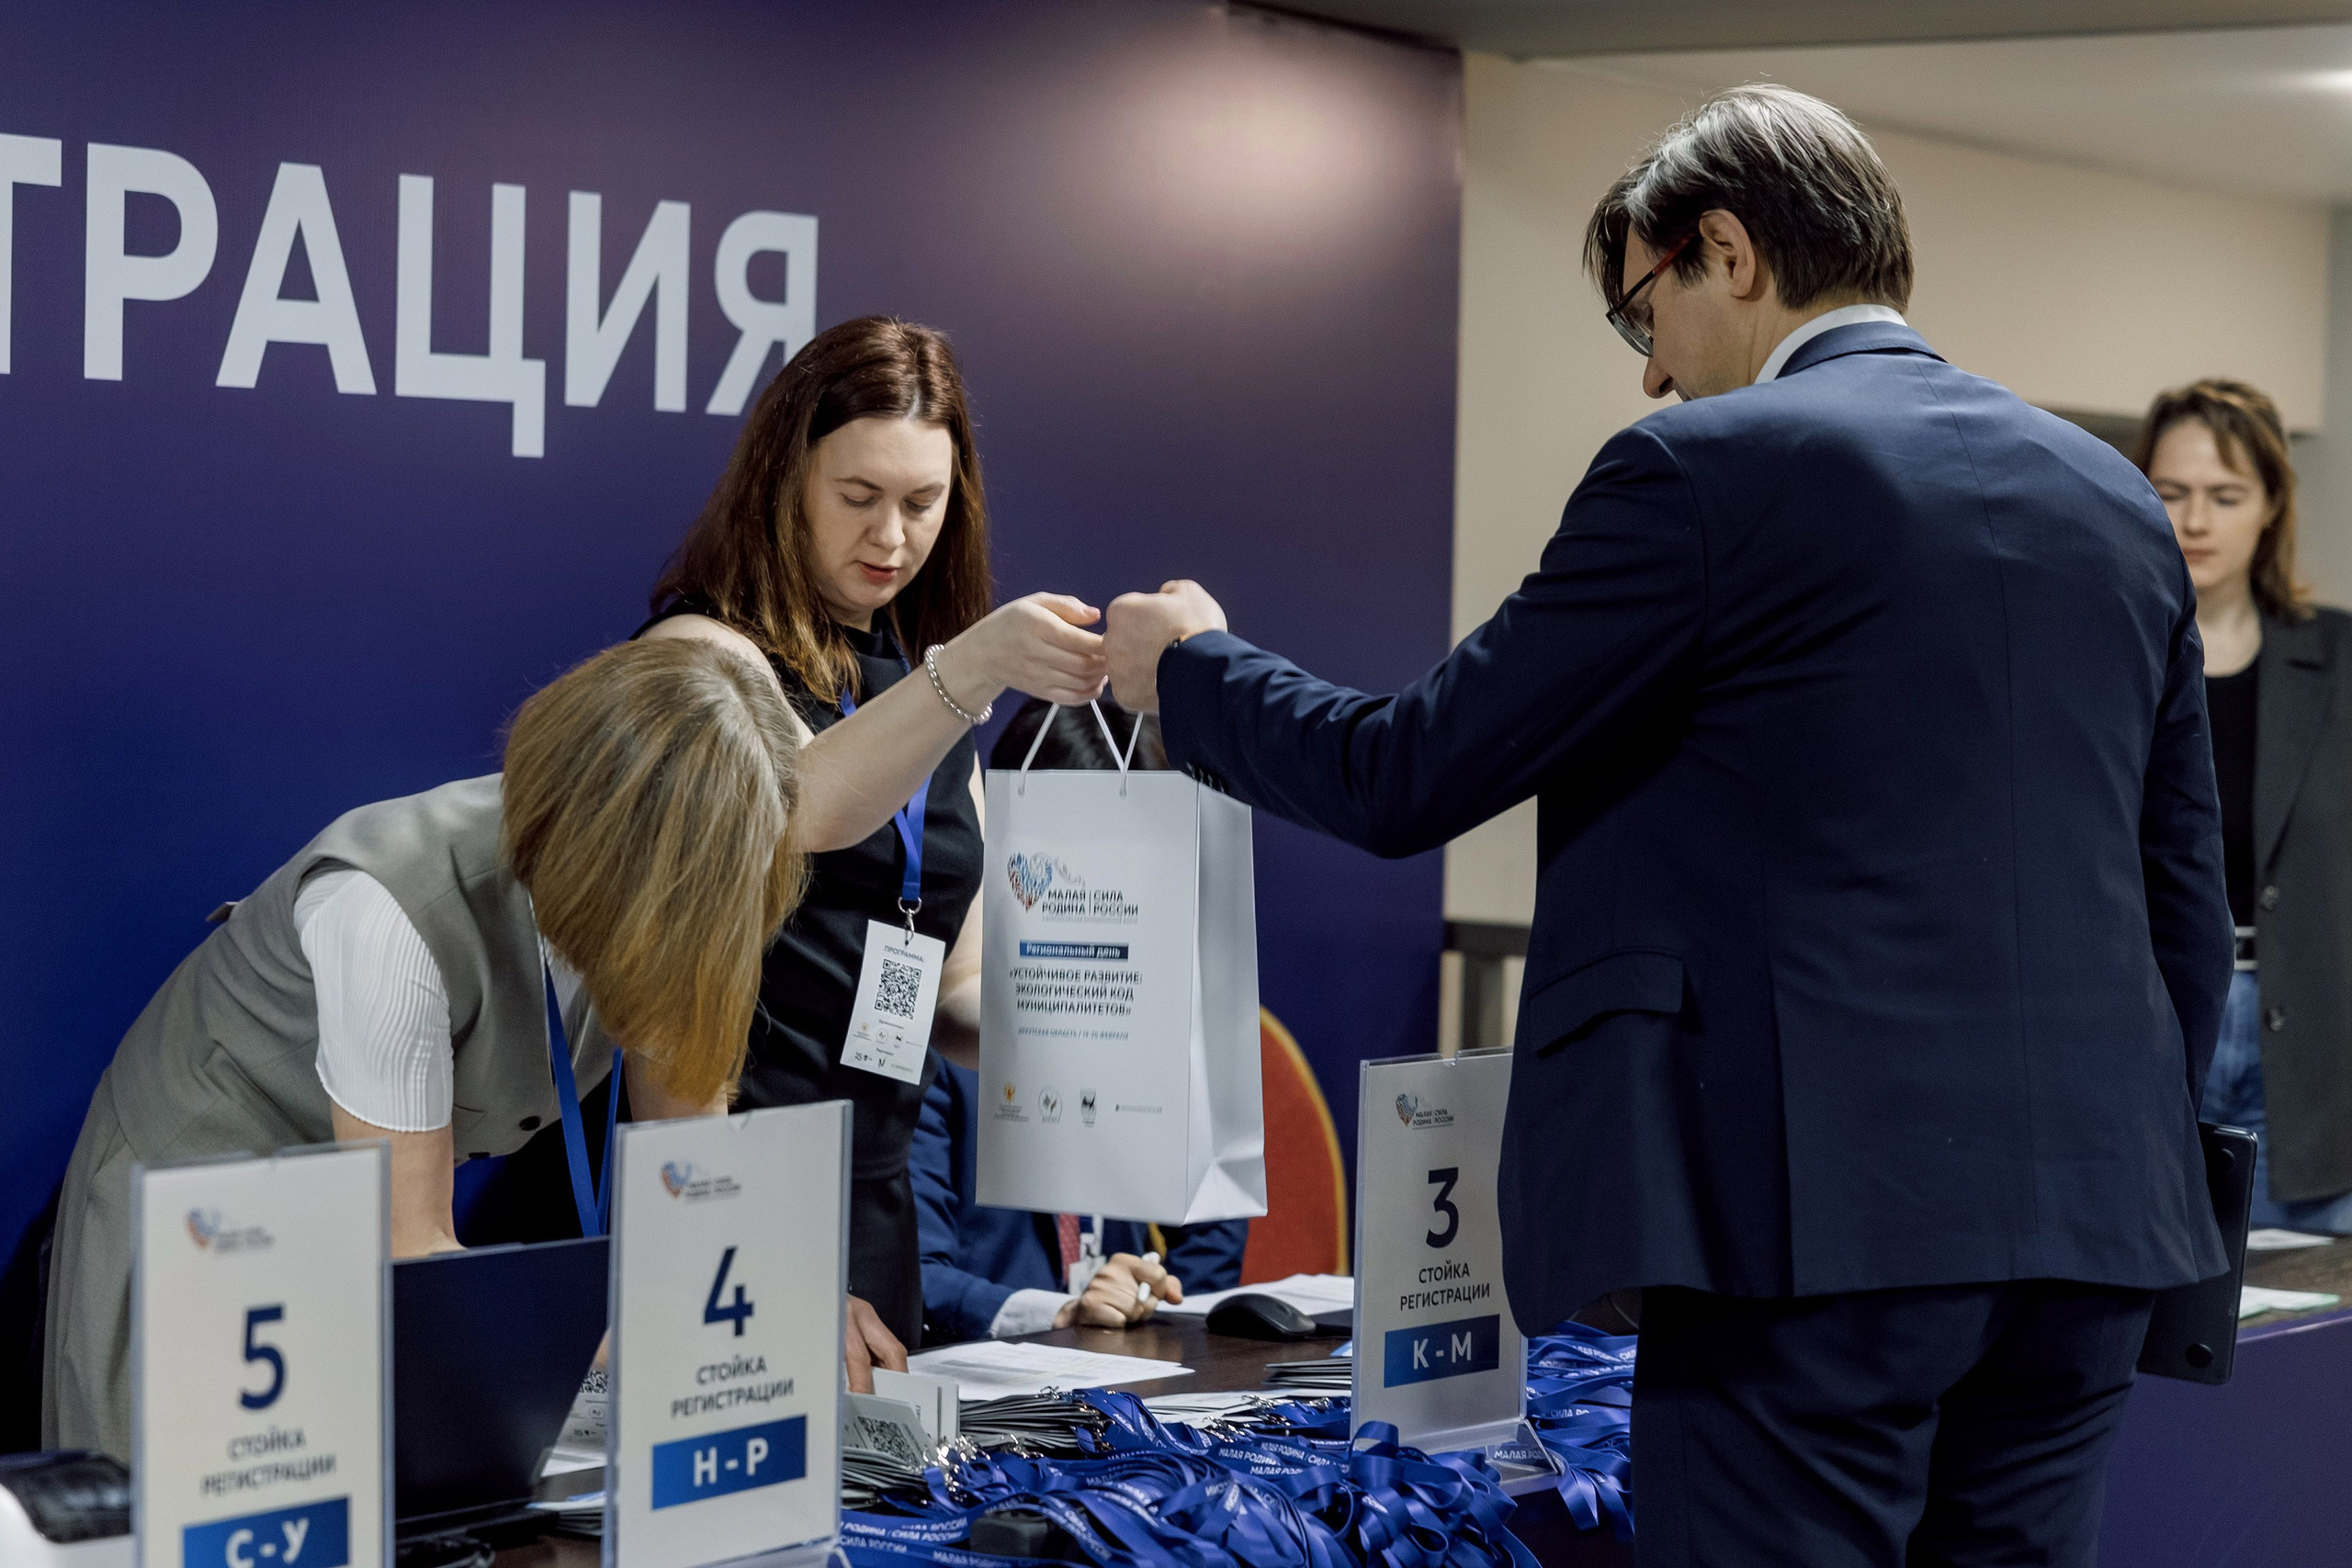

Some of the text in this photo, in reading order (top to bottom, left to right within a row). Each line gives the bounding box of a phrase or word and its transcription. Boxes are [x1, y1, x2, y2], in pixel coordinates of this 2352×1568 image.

[1048, 889, 1086, 901] МАЛАЯ
[1093, 890, 1124, 901] СИЛА
[1042, 902, 1086, 916] РОДИНА
[1093, 902, 1138, 917] РОССИИ
[1025, 943, 1121, 959] Региональный день
[1015, 982, 1135, 1002] ЭКОЛОГИЧЕСКИЙ КОД
[1426, 1167, 1459, 1248] 3
[1419, 1258, 1470, 1284] СТОЙКА
[703, 1245, 753, 1338] 4
[1400, 1283, 1490, 1312] РЕГИСТРАЦИИ
[239, 1303, 287, 1412] 5
[695, 1355, 767, 1387] СТОЙКА
[671, 1379, 795, 1419] РЕГИСТРАЦИИ
[227, 1427, 307, 1461] СТОЙКА
[1218, 1448, 1243, 1460] МАЛАЯ
[1494, 1450, 1527, 1460] МАЛАЯ
[201, 1452, 336, 1497] РЕГИСТРАЦИИ
[1250, 1466, 1281, 1475] МАЛАЯ
